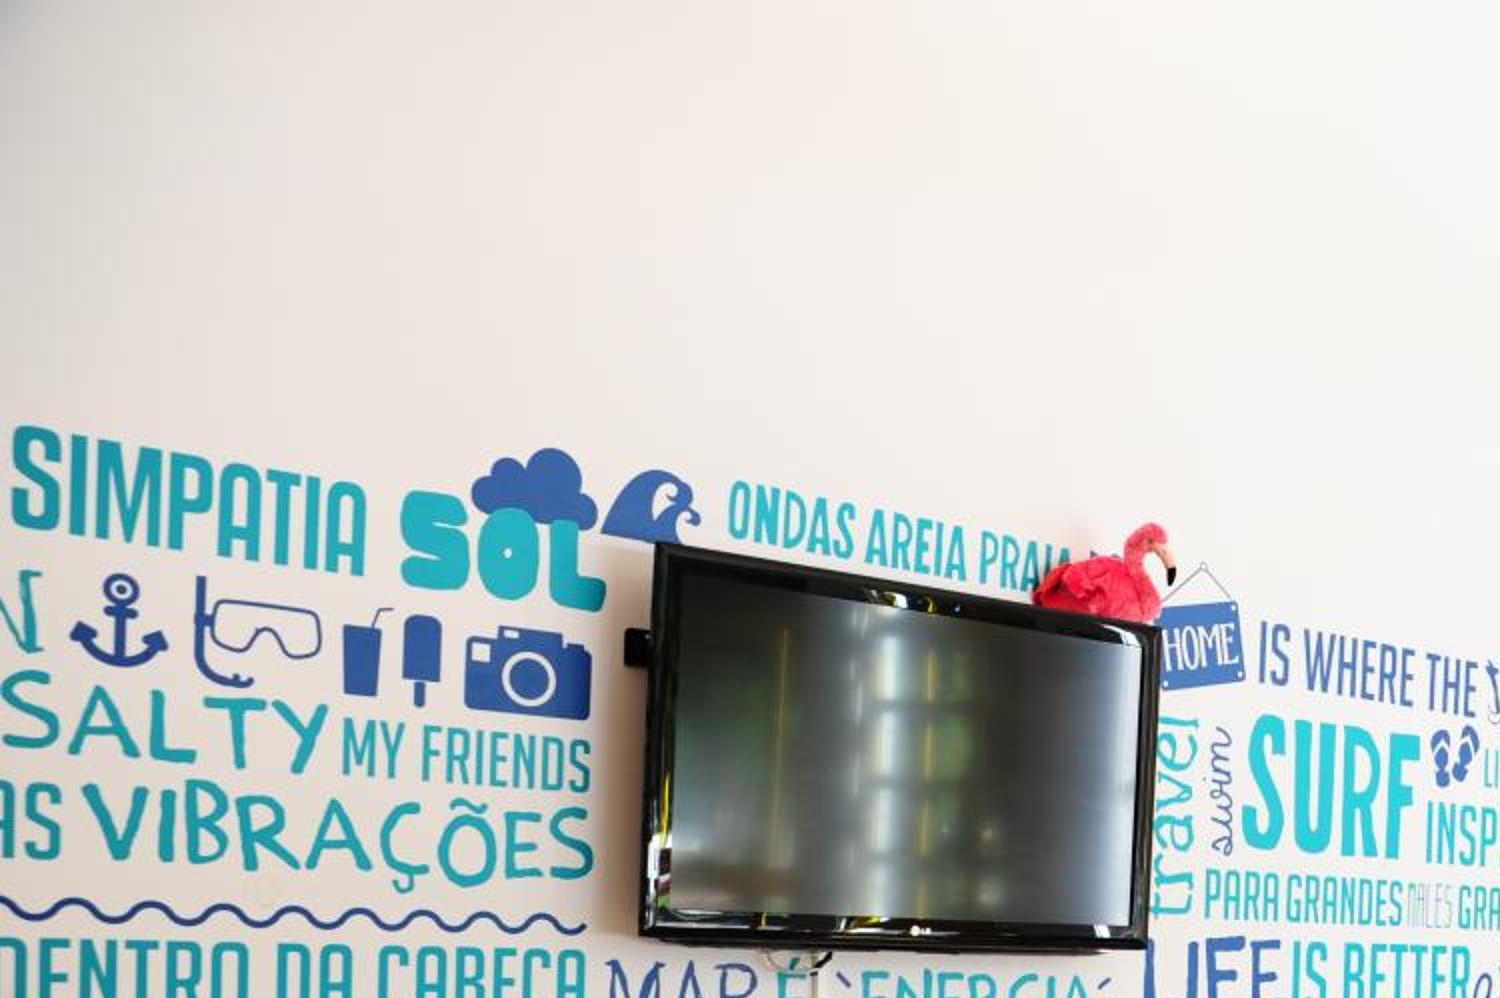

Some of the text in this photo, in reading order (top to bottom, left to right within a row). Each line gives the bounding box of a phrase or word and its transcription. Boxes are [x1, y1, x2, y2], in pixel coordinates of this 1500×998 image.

[10, 424, 368, 578] SIMPATIA
[399, 488, 608, 614] SOL
[726, 479, 858, 561] ONDAS
[864, 507, 969, 585] AREIA
[0, 668, 592, 795] SALTY MY FRIENDS
[1161, 622, 1240, 672] HOME
[1257, 620, 1292, 687] IS
[1303, 628, 1416, 708] WHERE
[1426, 652, 1479, 719] THE
[81, 777, 596, 893] VIBRAÇÕES
[1206, 725, 1235, 858] swim
[1240, 712, 1423, 862] SURF
[1203, 867, 1281, 923] PARA
[1285, 872, 1405, 928] GRANDES
